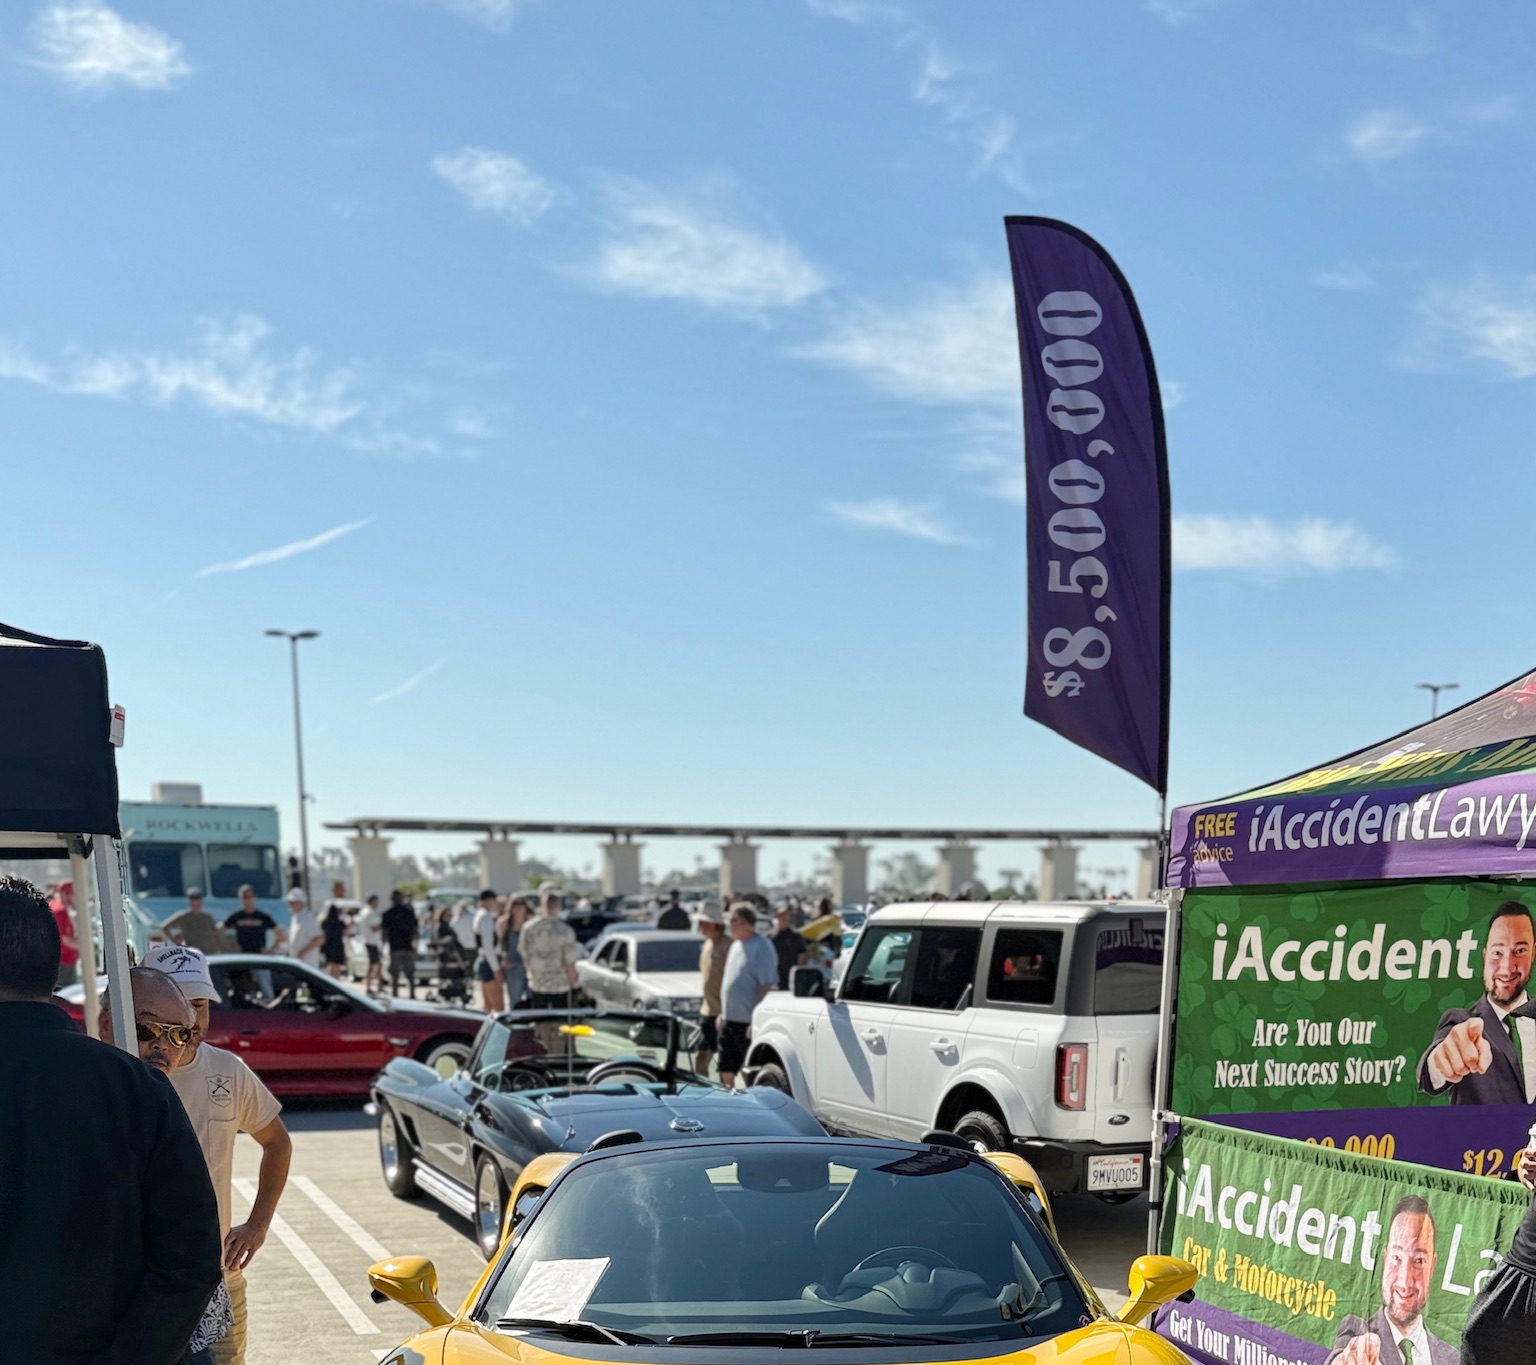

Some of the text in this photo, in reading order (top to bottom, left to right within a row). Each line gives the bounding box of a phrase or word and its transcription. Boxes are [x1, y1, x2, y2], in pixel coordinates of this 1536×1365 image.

[1037, 290, 1116, 697] $8,500,000
[1194, 812, 1238, 839] FREE
[1193, 843, 1234, 864] advice
[1212, 923, 1478, 981] iAccident
[1251, 1017, 1376, 1047] Are You Our
[1214, 1055, 1406, 1088] Next Success Story?
[1092, 1167, 1138, 1185] 9MVU005
[1177, 1157, 1382, 1272] iAccident
[1183, 1236, 1337, 1321] Car & Motorcycle
[1169, 1309, 1193, 1342] Get
[1196, 1319, 1231, 1359] Your
